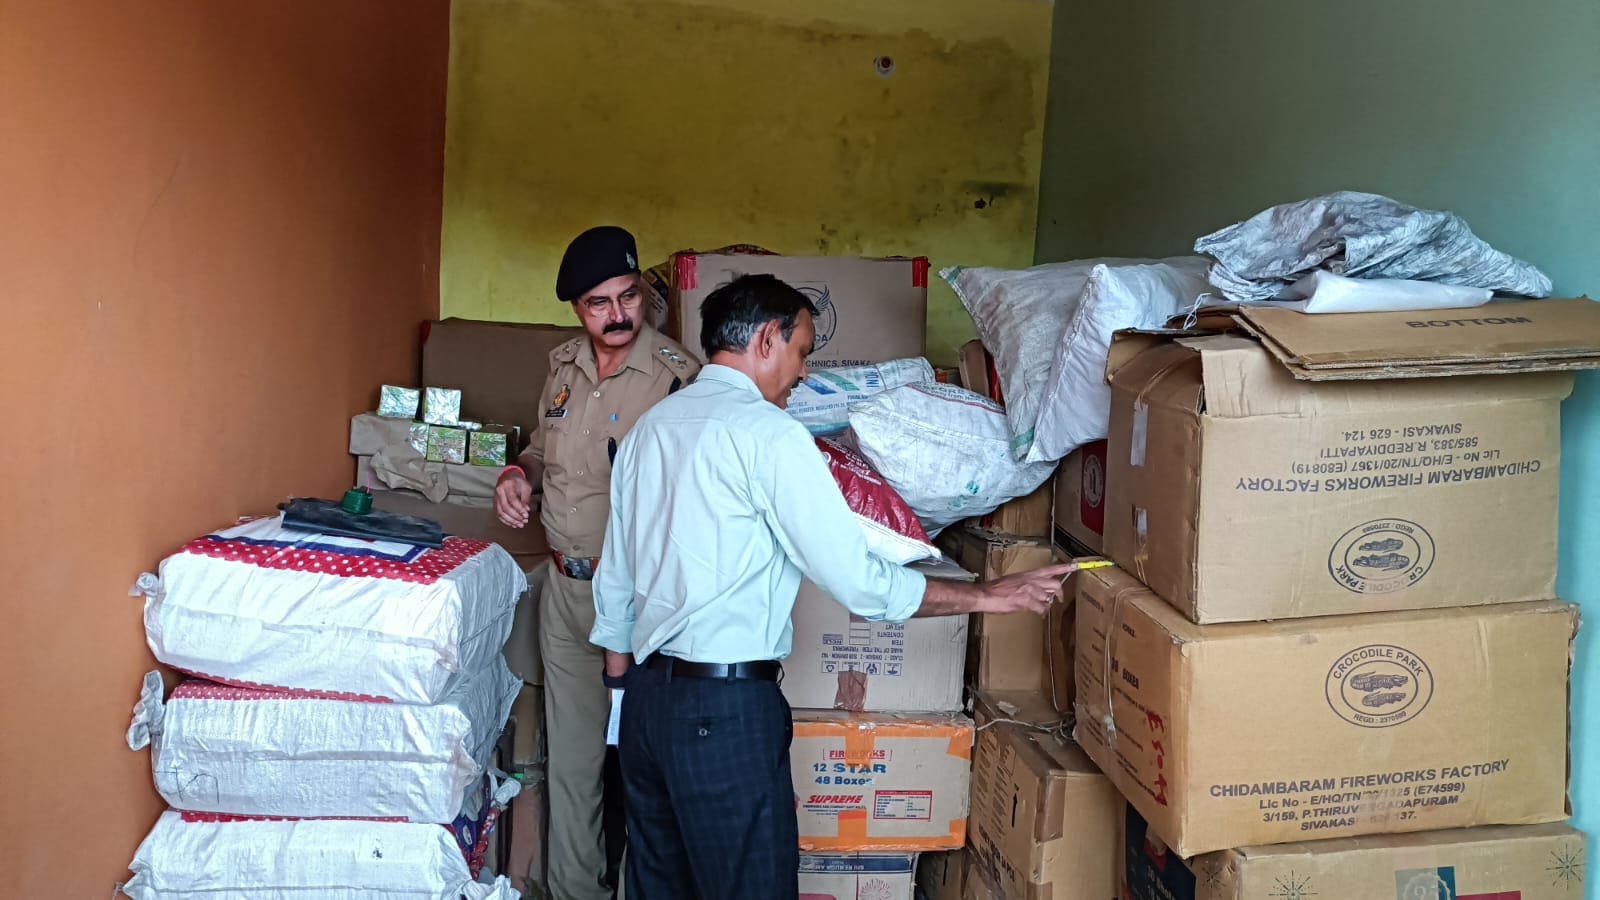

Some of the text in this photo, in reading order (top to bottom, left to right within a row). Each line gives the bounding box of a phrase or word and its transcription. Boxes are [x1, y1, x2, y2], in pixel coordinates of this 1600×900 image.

[1405, 316, 1532, 329] BOTTOM
[805, 360, 840, 368] CHNICS,
[1341, 430, 1365, 441] 124.
[1370, 428, 1391, 439] 626
[1403, 423, 1462, 437] SIVAKASI
[1320, 436, 1478, 458] 585/383, R.REDDIYAPATTI
[1463, 452, 1480, 461] No
[1483, 449, 1500, 462] Lic
[1292, 461, 1348, 475] (E80819)
[1351, 454, 1453, 472] E/HQ/TN/20/1367
[1235, 460, 1540, 492] CHIDAMBARAM FIREWORKS FACTORY
[1336, 565, 1359, 588] PARK
[1333, 648, 1423, 679] CROCODILE PARK
[829, 750, 886, 758] FIRKS
[813, 763, 887, 774] 12 STAR
[815, 776, 831, 785] 48
[1210, 759, 1509, 797] CHIDAMBARAM FIREWORKS FACTORY
[807, 795, 864, 804] SUPREME
[1259, 798, 1280, 809] Lic
[1282, 797, 1299, 807] No
[1414, 782, 1465, 796] (E74599)
[1263, 810, 1298, 823] 3/159,
